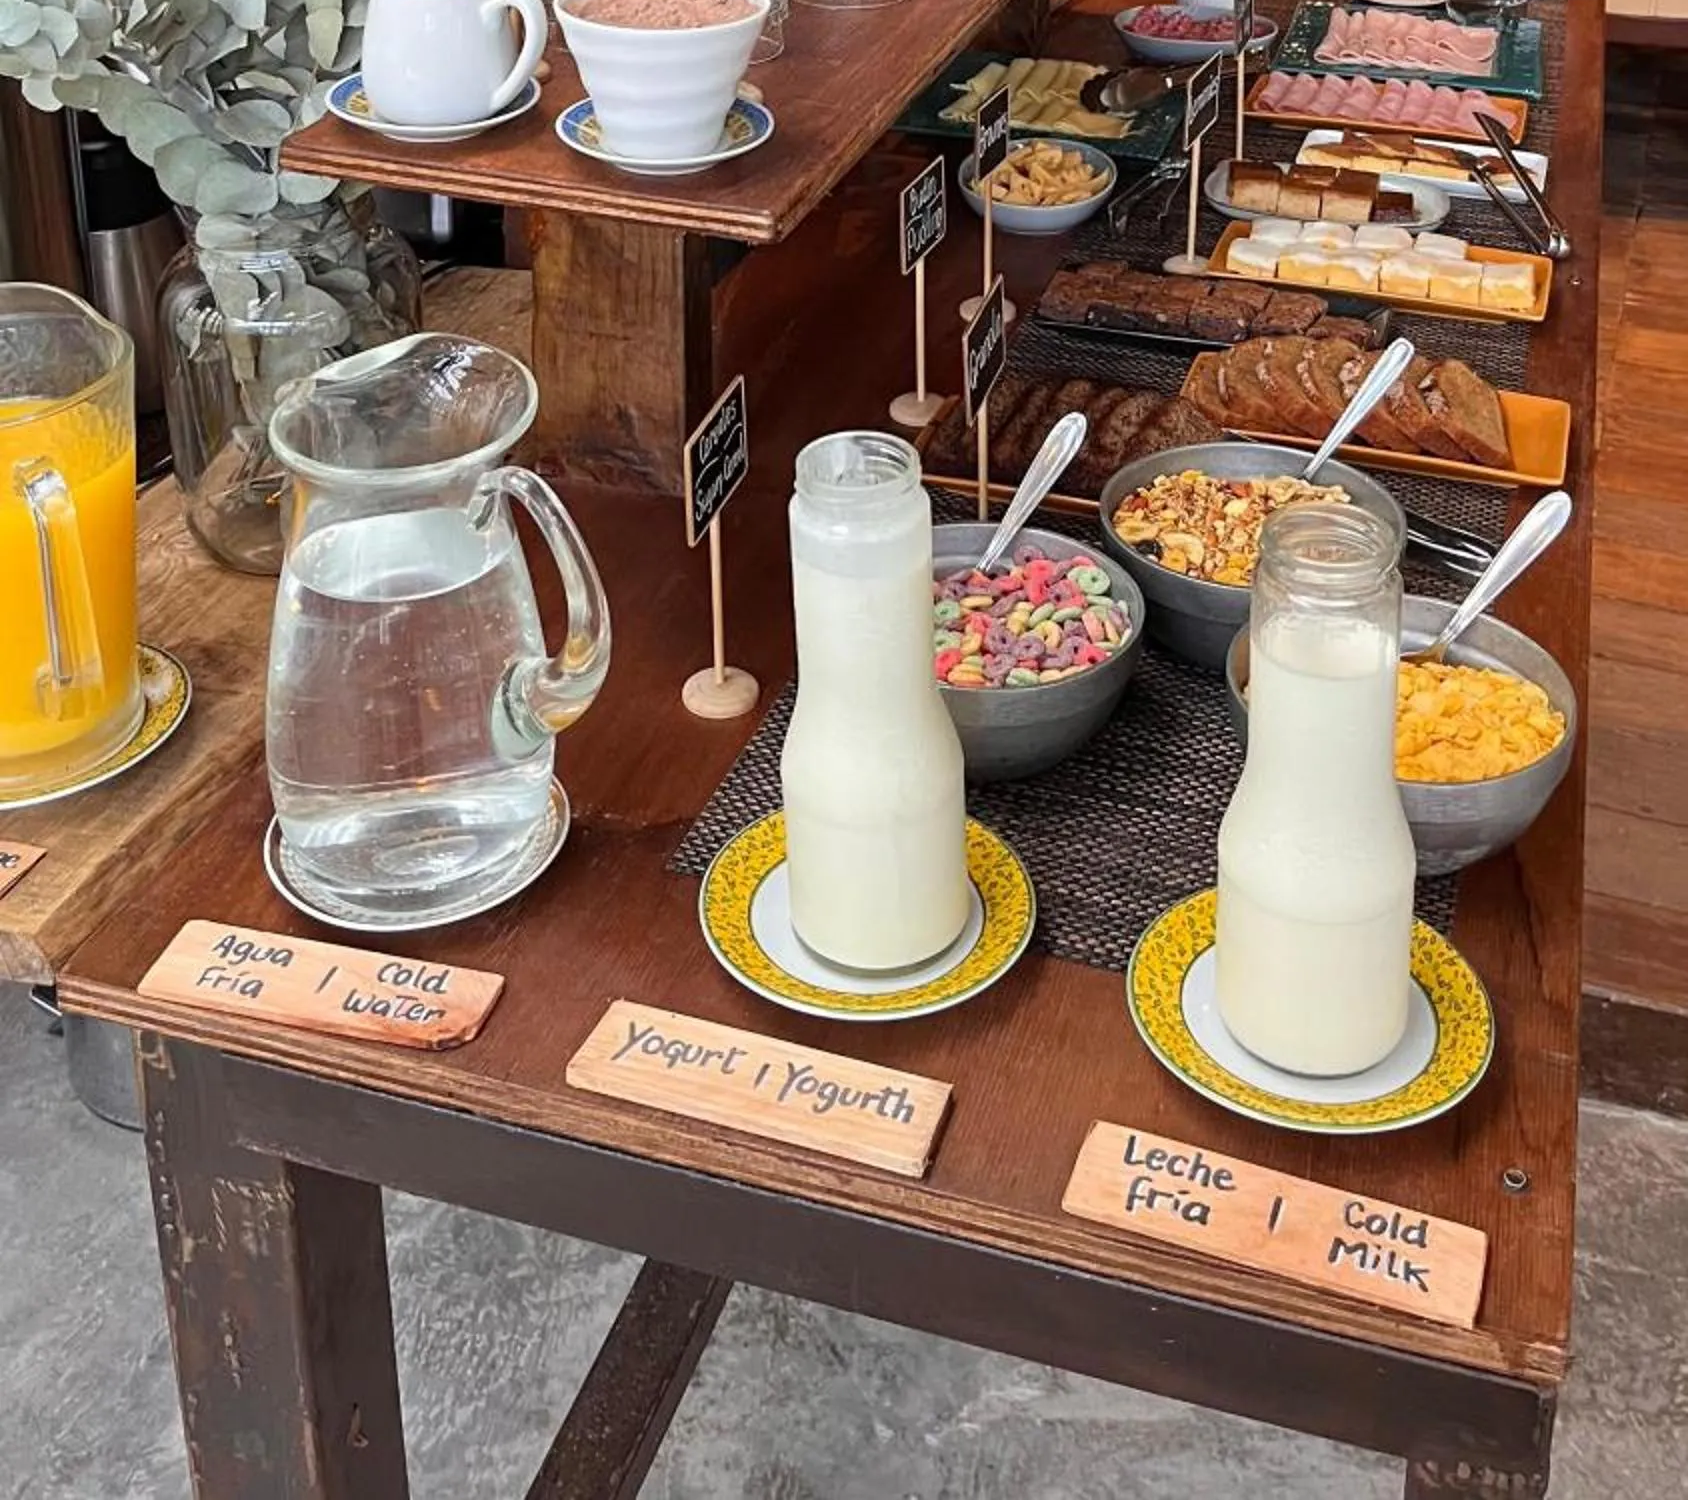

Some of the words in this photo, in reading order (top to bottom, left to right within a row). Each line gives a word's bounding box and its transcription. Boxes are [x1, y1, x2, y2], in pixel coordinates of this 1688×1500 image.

[211, 934, 294, 968] Agua
[377, 961, 451, 995] Cold
[610, 1020, 749, 1075] Yogurt
[776, 1060, 916, 1125] Yogurth
[1123, 1134, 1237, 1192] Leche
[1344, 1200, 1430, 1250] Cold
